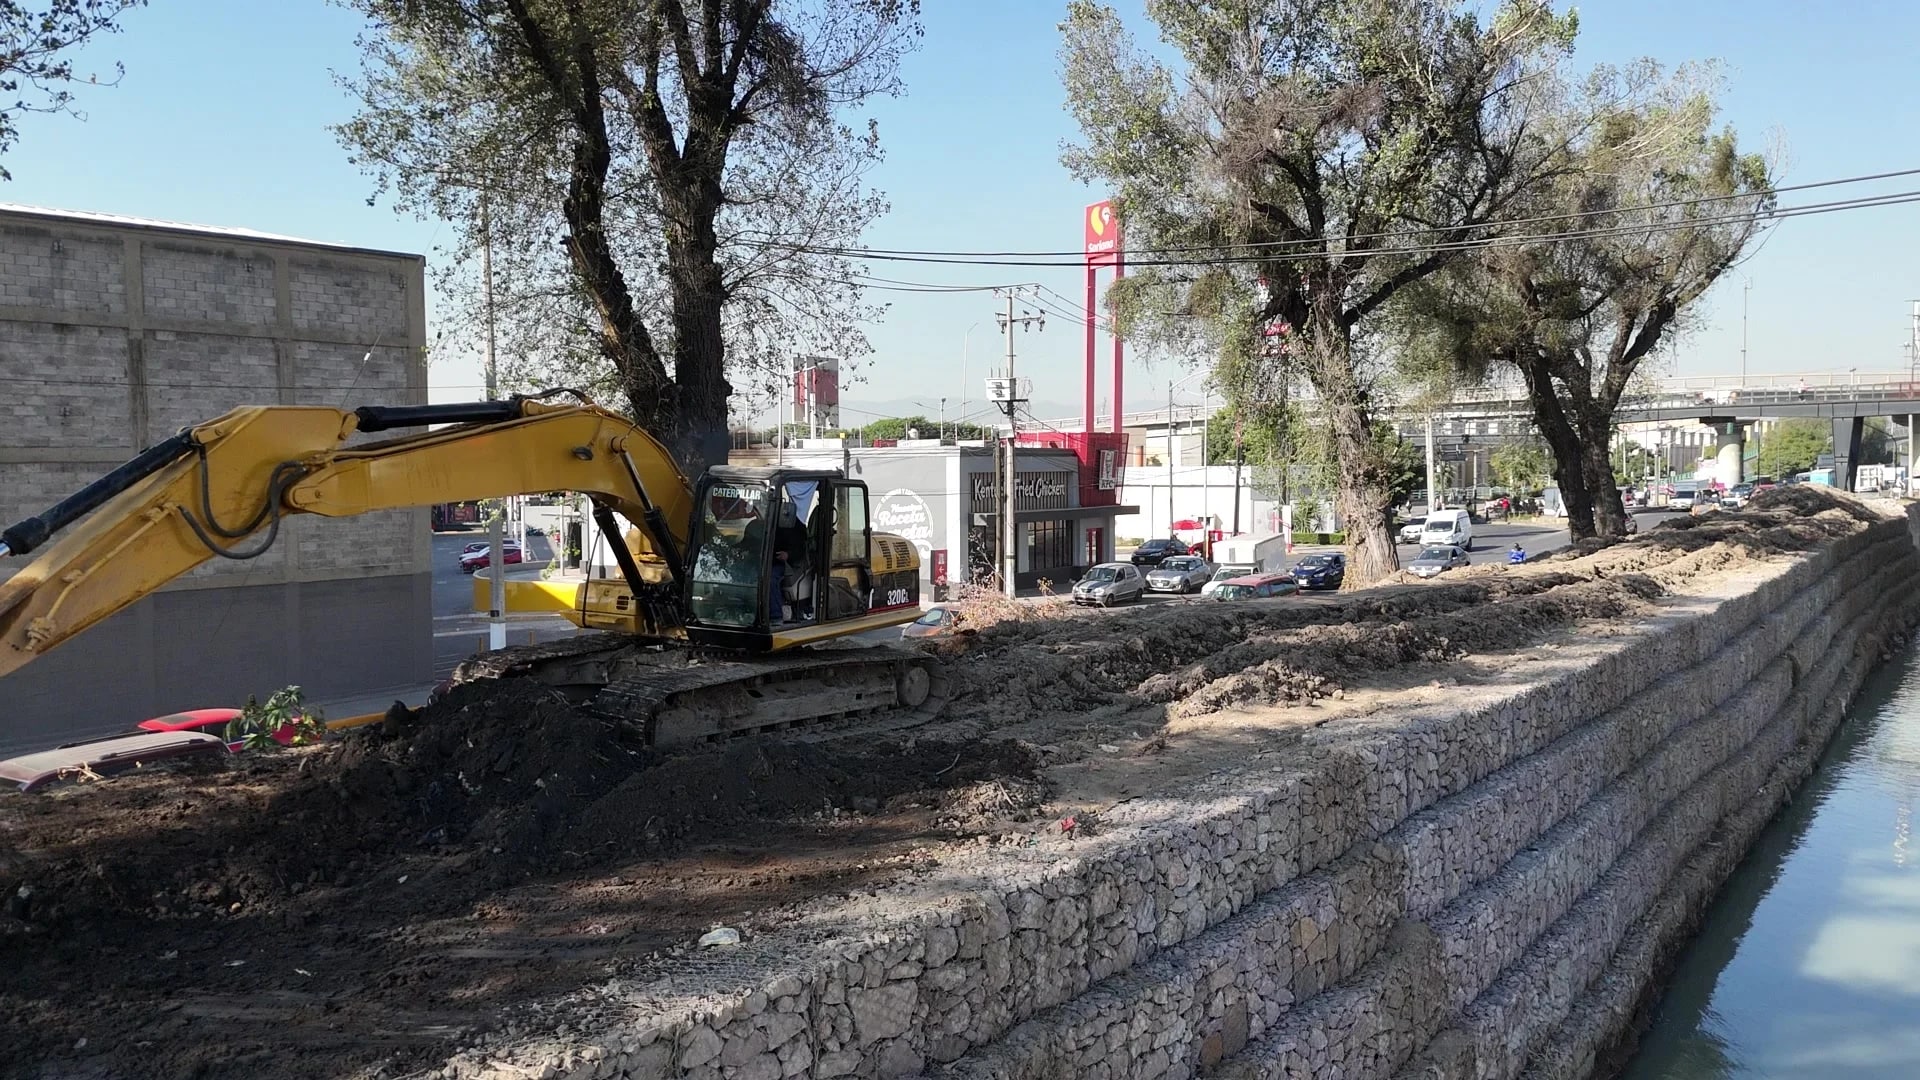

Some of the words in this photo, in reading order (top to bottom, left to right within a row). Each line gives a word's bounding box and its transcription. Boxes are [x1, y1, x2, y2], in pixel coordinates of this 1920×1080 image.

[1014, 478, 1034, 500] Fried
[1036, 477, 1065, 499] Chicken
[1101, 480, 1113, 488] KFC
[713, 487, 761, 501] CATERPILLAR
[879, 510, 926, 526] Receta
